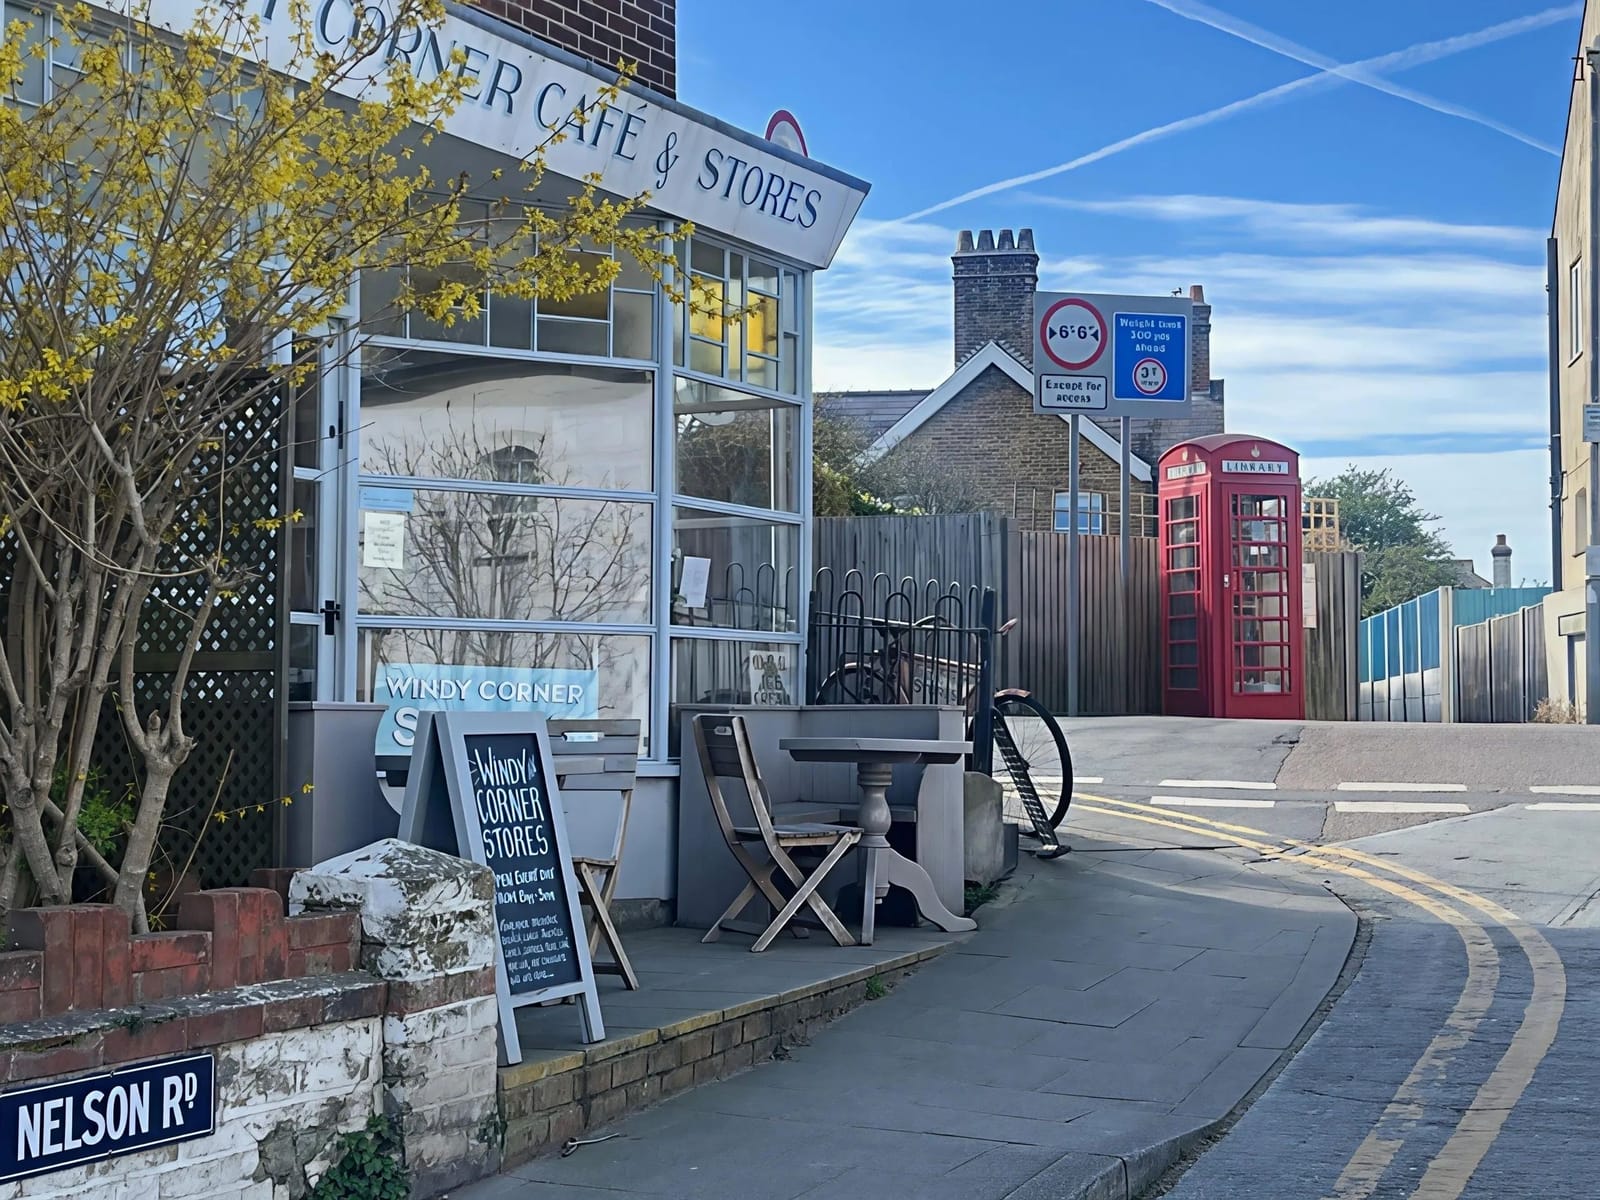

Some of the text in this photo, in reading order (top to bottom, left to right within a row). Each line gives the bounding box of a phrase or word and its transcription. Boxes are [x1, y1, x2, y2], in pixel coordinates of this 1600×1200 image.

[318, 0, 821, 229] CORNER CAFÉ & STORES
[1045, 380, 1102, 391] Except for
[1056, 394, 1091, 403] access
[1227, 461, 1283, 473] LIBRARY
[387, 677, 585, 704] WINDY CORNER
[477, 787, 544, 824] CORNER
[483, 825, 548, 858] STORES
[495, 872, 514, 888] PEN
[495, 890, 517, 904] ROM
[17, 1080, 150, 1162] NELSON
